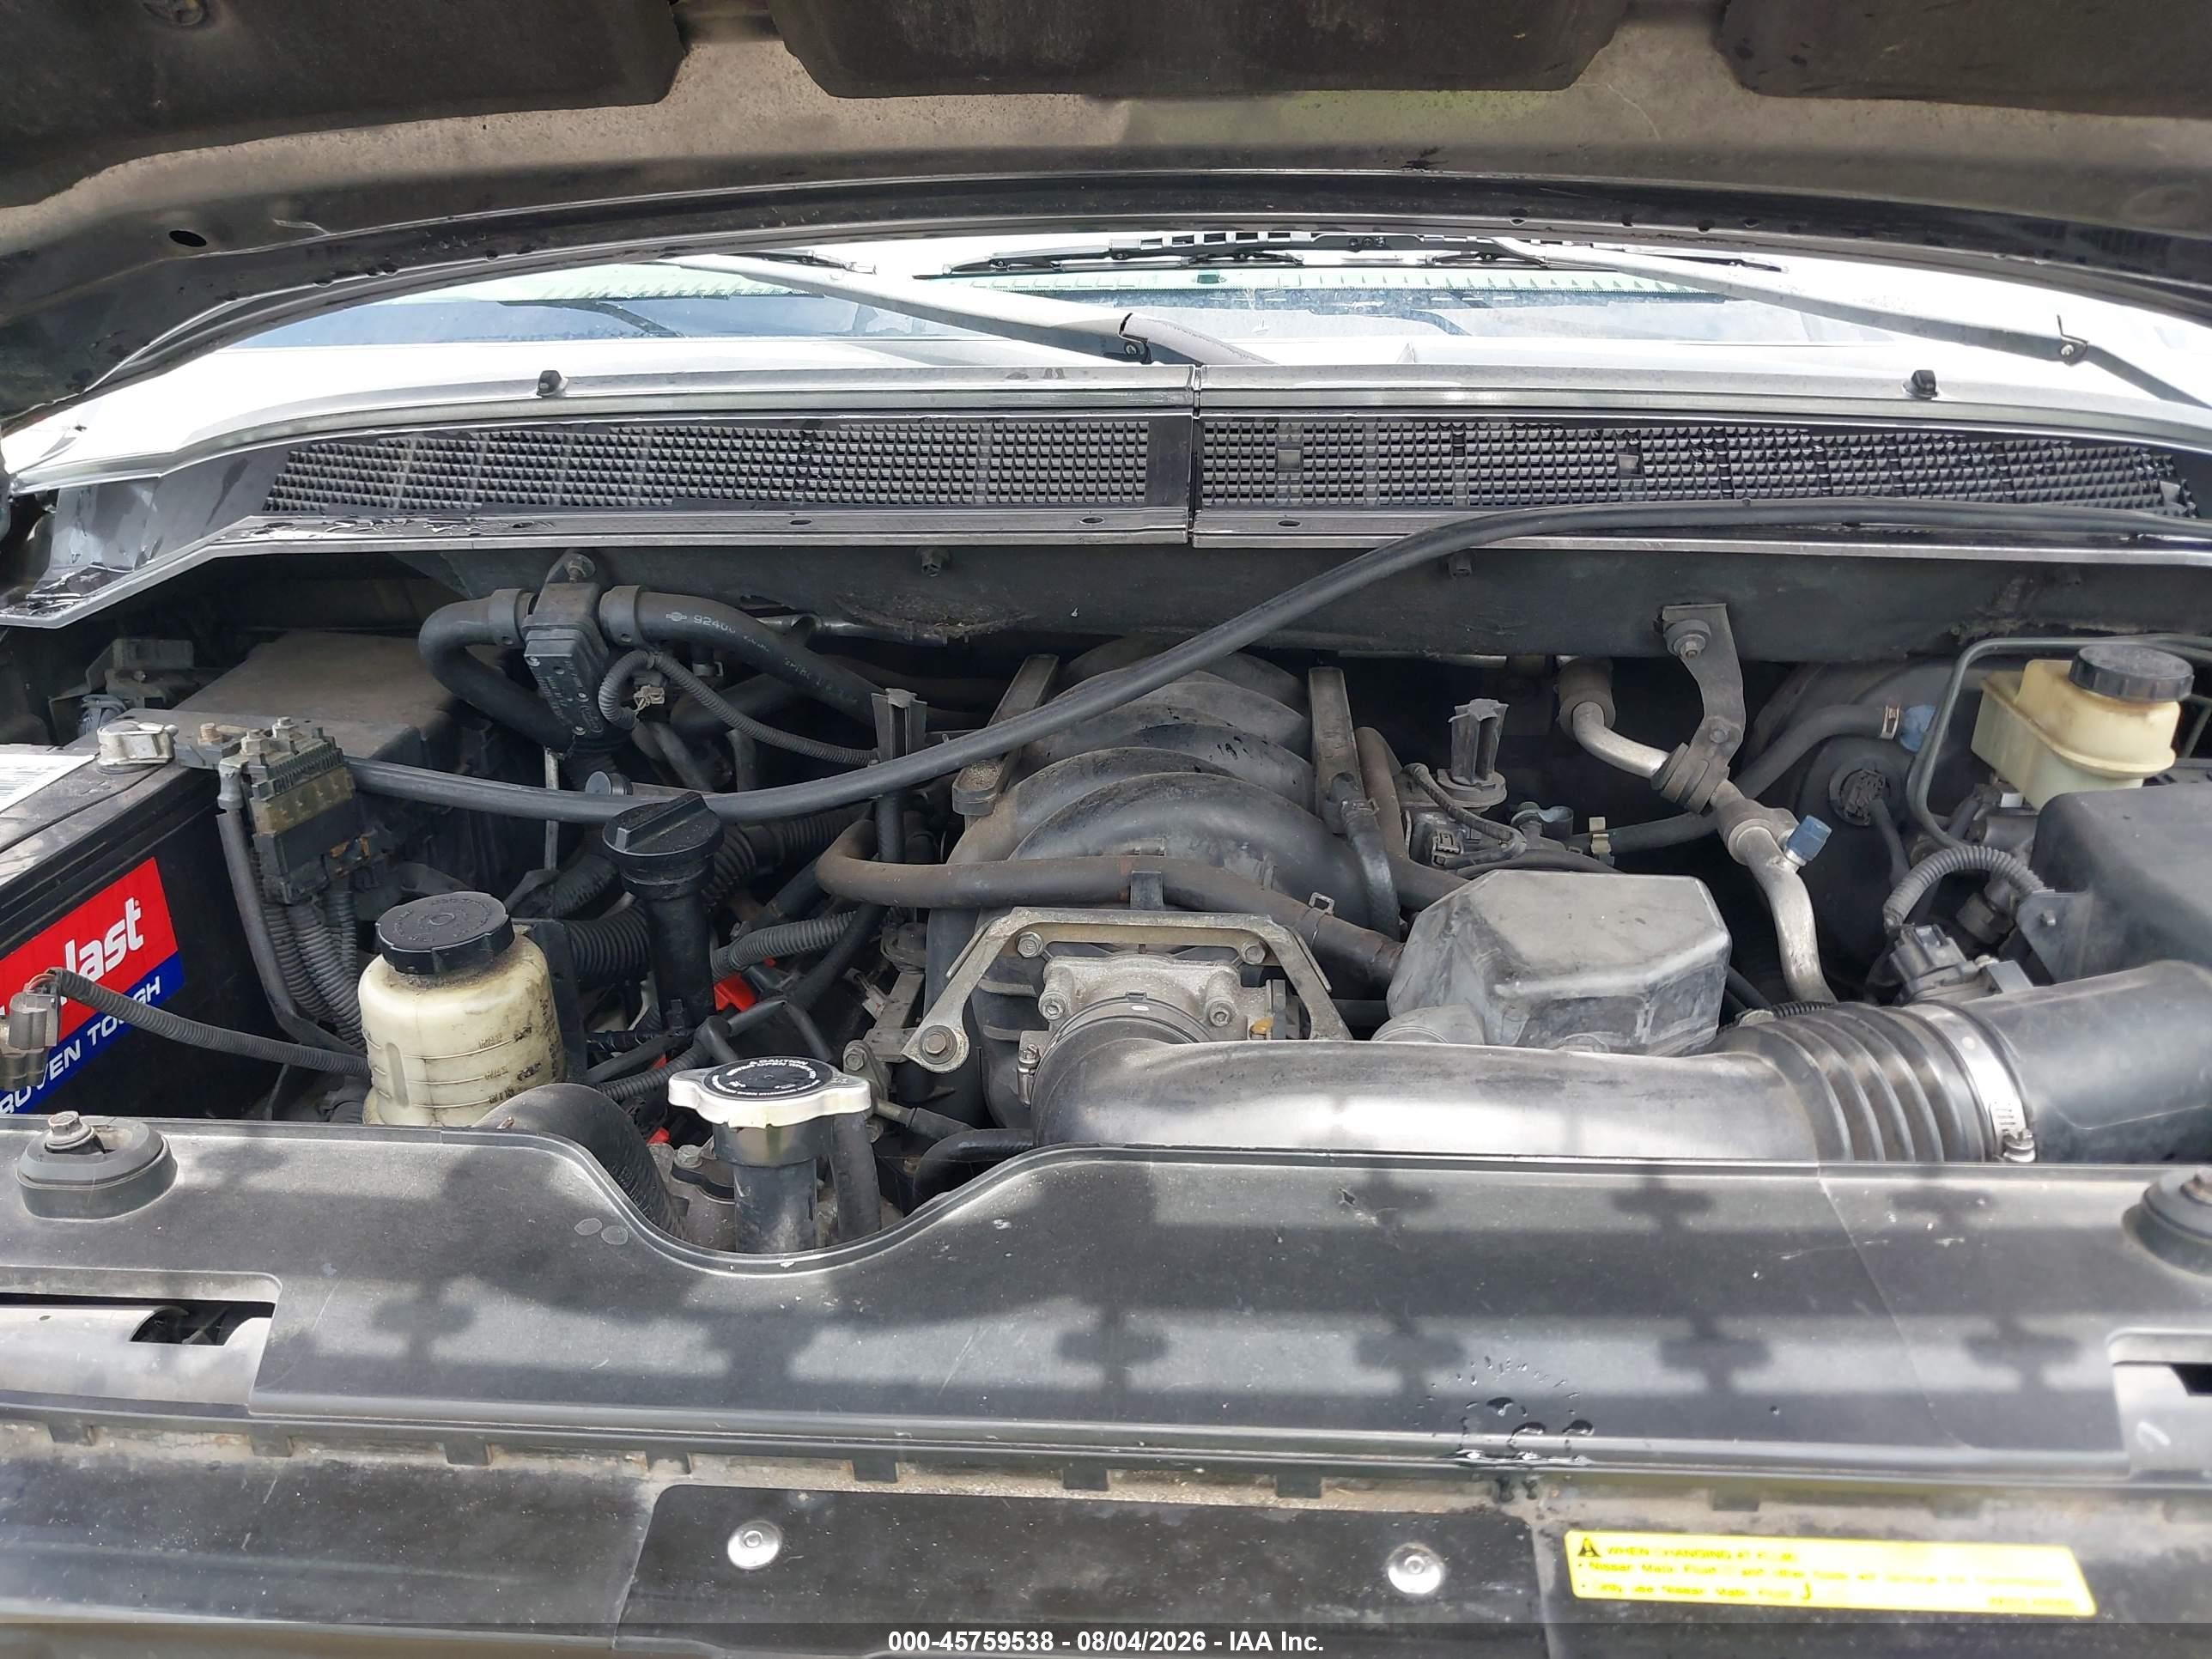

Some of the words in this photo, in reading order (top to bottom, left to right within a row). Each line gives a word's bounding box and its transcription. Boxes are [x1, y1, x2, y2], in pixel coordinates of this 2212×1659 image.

[0, 1039, 81, 1114] ROVEN
[87, 975, 161, 1046] TOGH
[1657, 1548, 1731, 1559] HANGING
